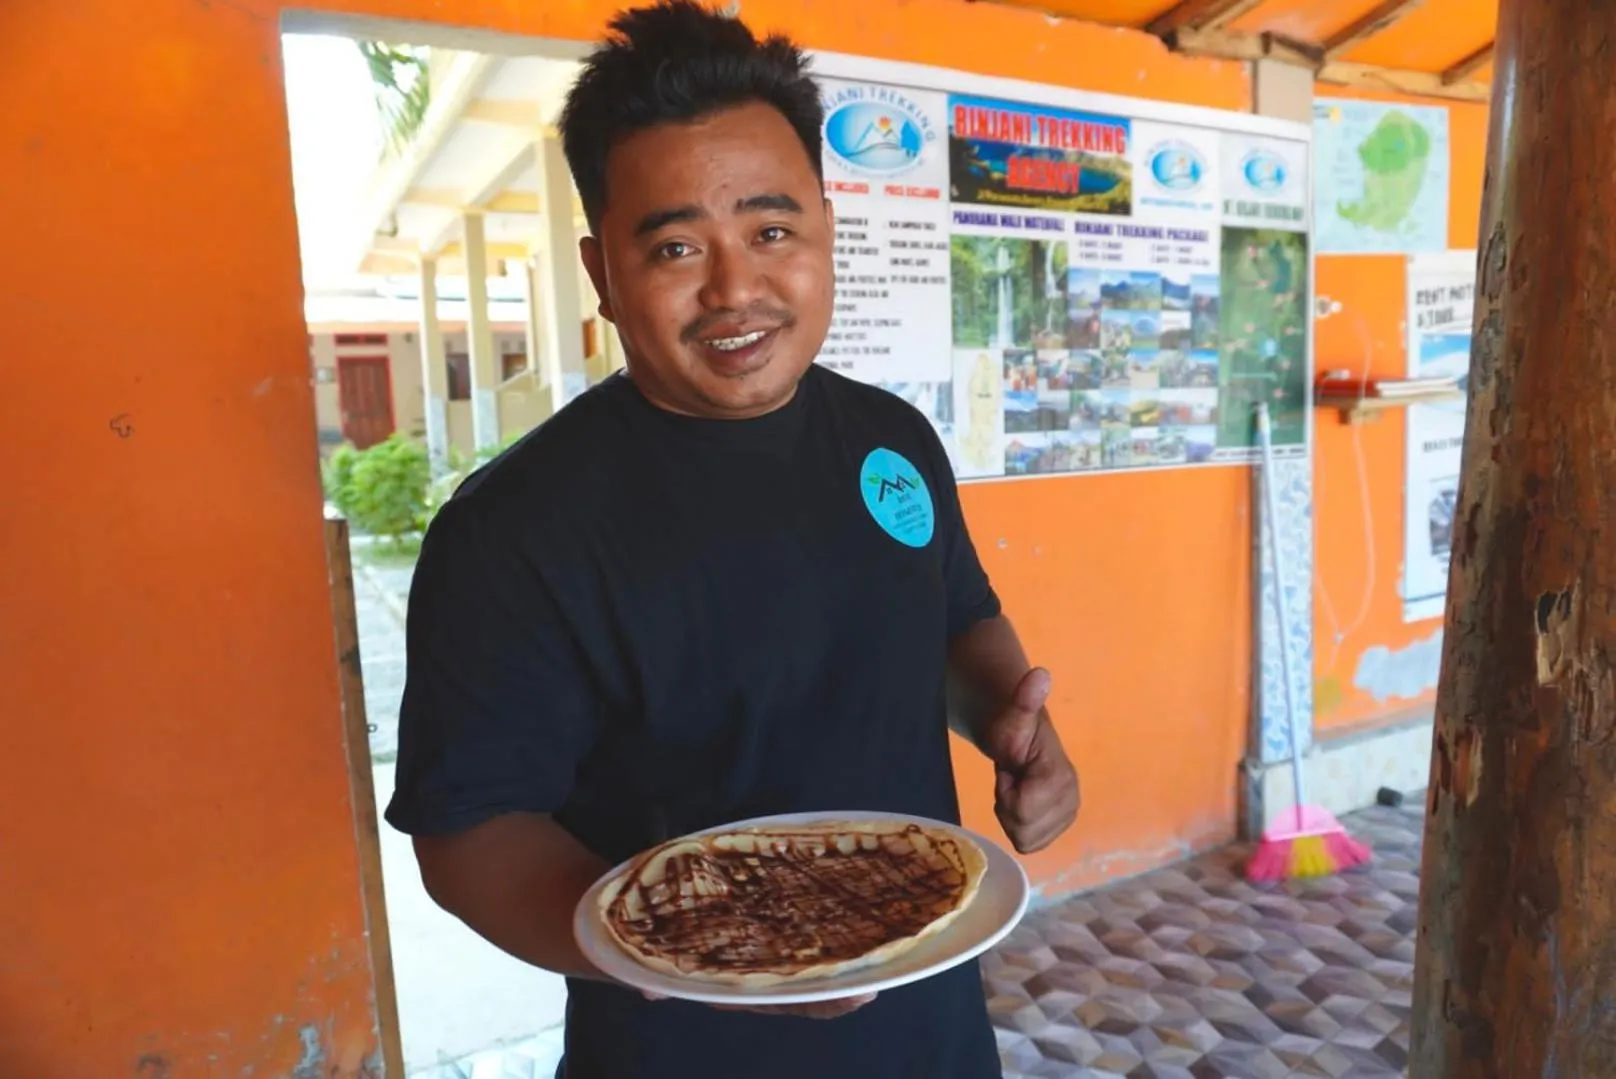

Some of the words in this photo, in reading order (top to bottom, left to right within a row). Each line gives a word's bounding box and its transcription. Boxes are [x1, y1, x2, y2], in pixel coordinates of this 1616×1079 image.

[870, 86, 936, 142] TREKKING
[954, 104, 1032, 145] RINJANI
[1037, 115, 1127, 156] TREKKING
[1006, 155, 1081, 195] AGENCY
[1074, 221, 1113, 236] RINJANI
[1116, 224, 1164, 240] TREKKING
